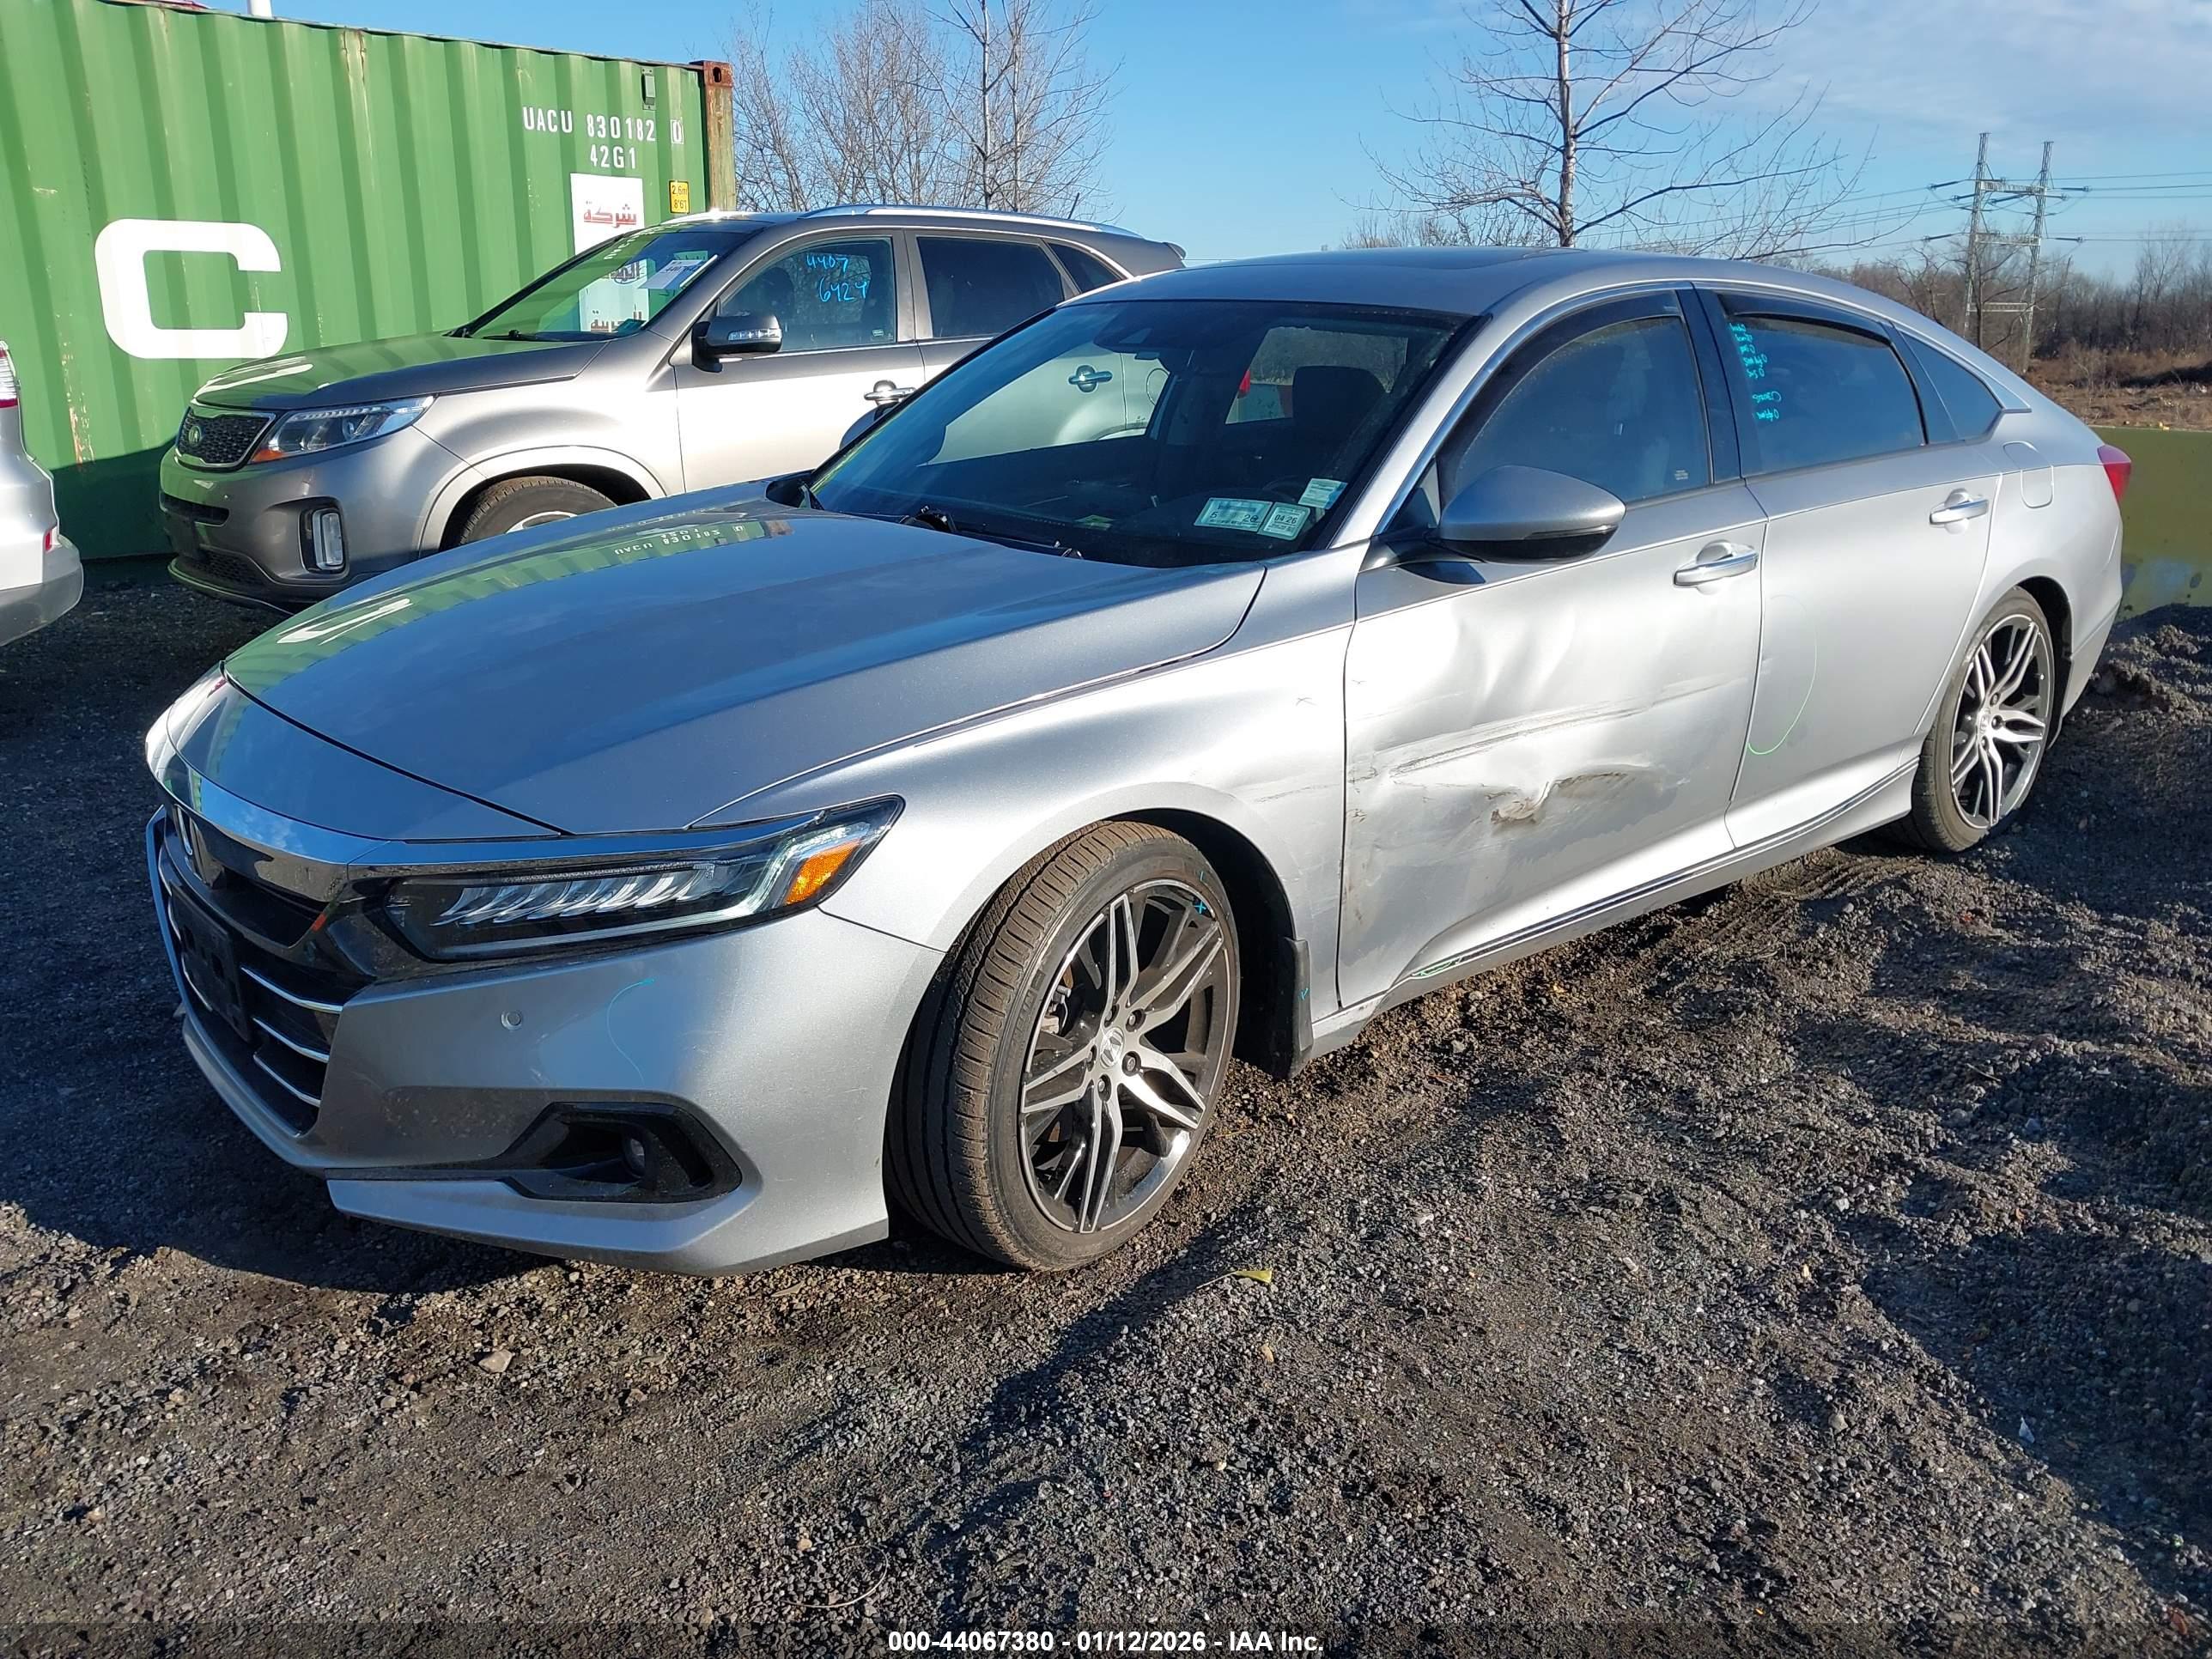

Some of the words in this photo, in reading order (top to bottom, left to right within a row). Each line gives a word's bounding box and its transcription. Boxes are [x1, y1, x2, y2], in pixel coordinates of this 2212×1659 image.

[522, 106, 573, 133] UACU
[586, 113, 655, 142] 830182
[590, 144, 636, 169] 42G1
[583, 200, 637, 228] شركة
[94, 219, 288, 359] C
